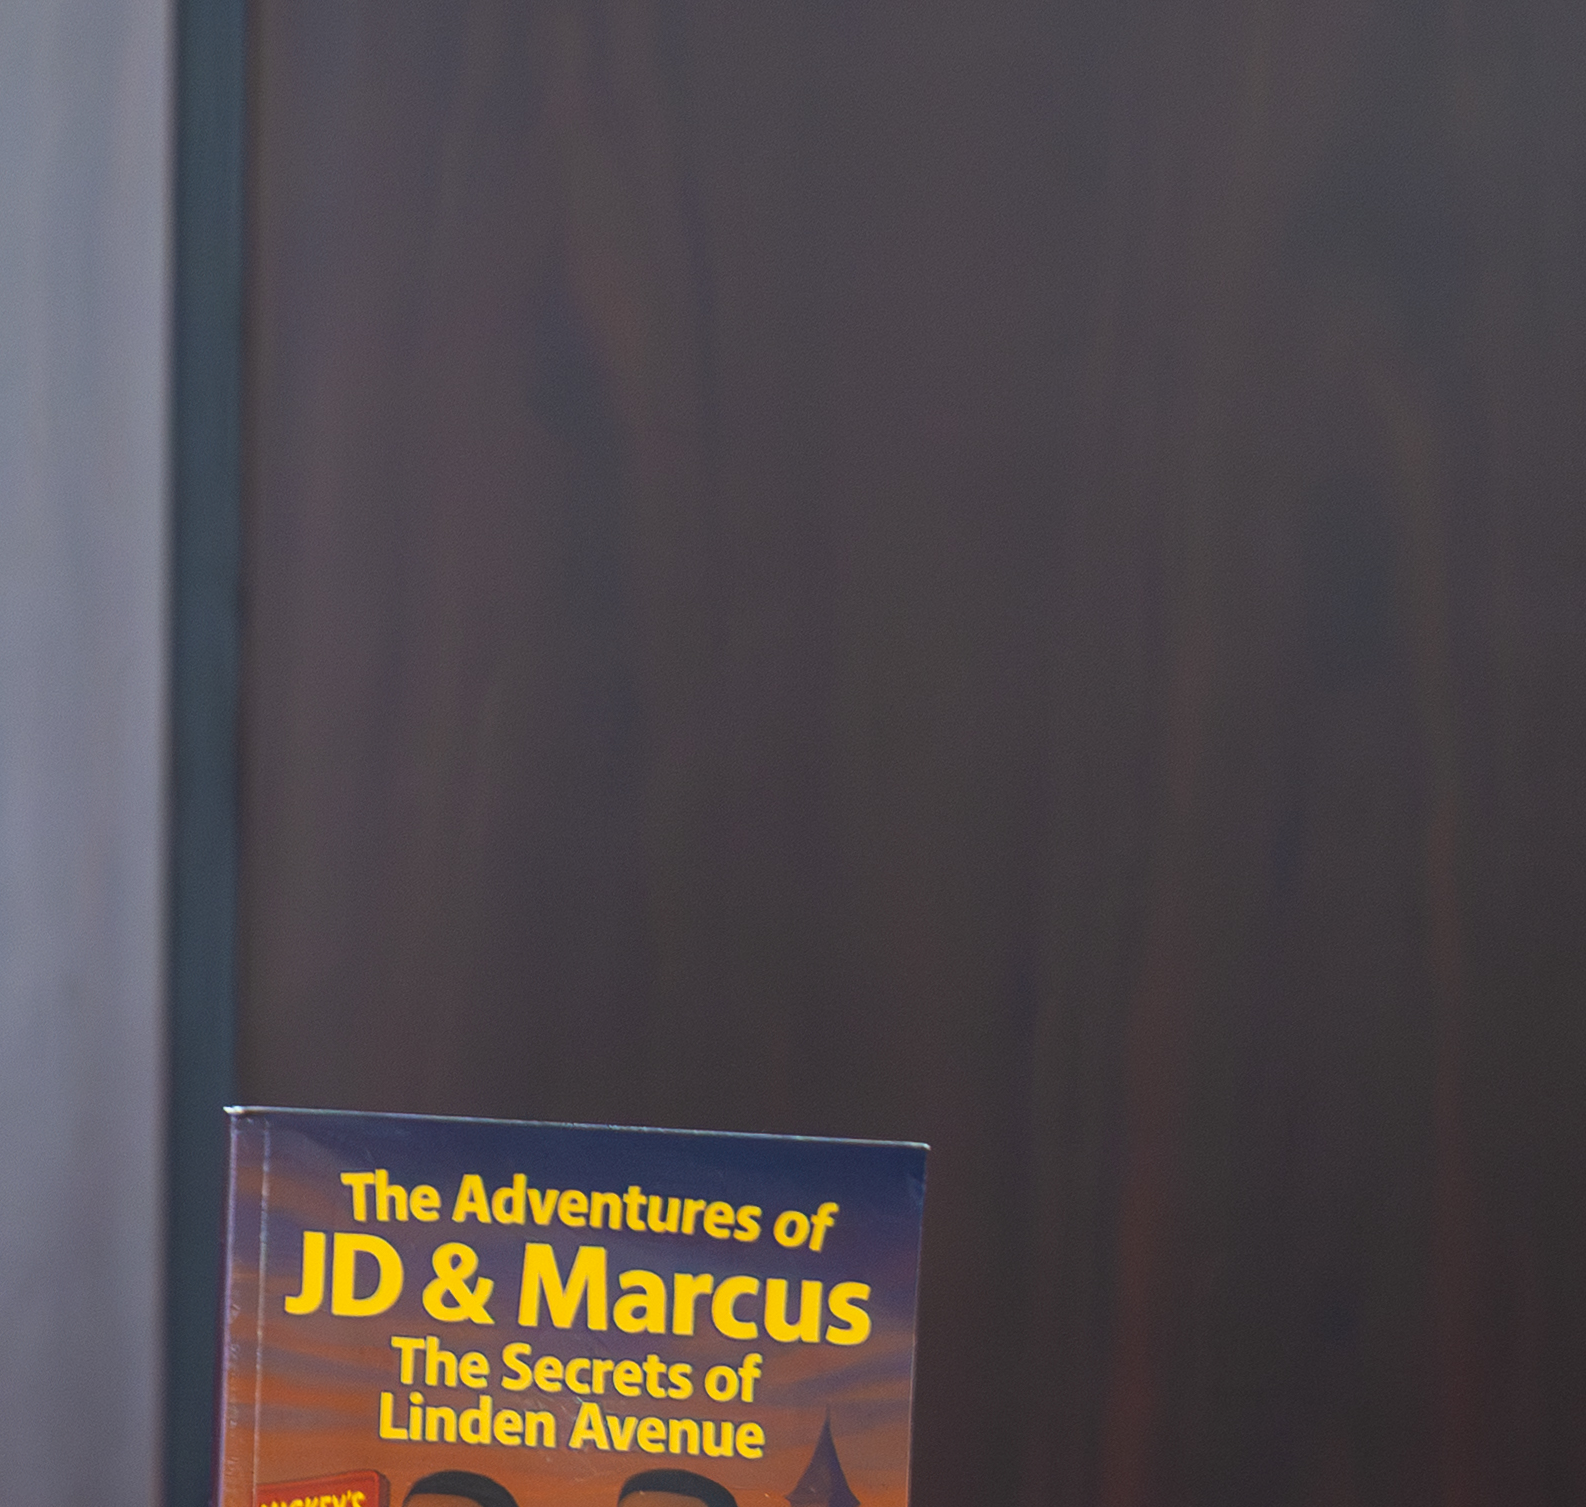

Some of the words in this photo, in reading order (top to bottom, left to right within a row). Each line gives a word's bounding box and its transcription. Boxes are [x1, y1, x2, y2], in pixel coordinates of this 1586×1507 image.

[340, 1169, 442, 1222] The
[452, 1173, 762, 1243] Adventures
[773, 1202, 840, 1252] of
[284, 1231, 405, 1317] JD
[422, 1242, 495, 1325] &
[516, 1242, 873, 1346] Marcus
[391, 1336, 490, 1390] The
[500, 1343, 693, 1402] Secrets
[704, 1353, 764, 1403] of
[378, 1392, 558, 1450] Linden
[569, 1402, 766, 1460] Avenue
